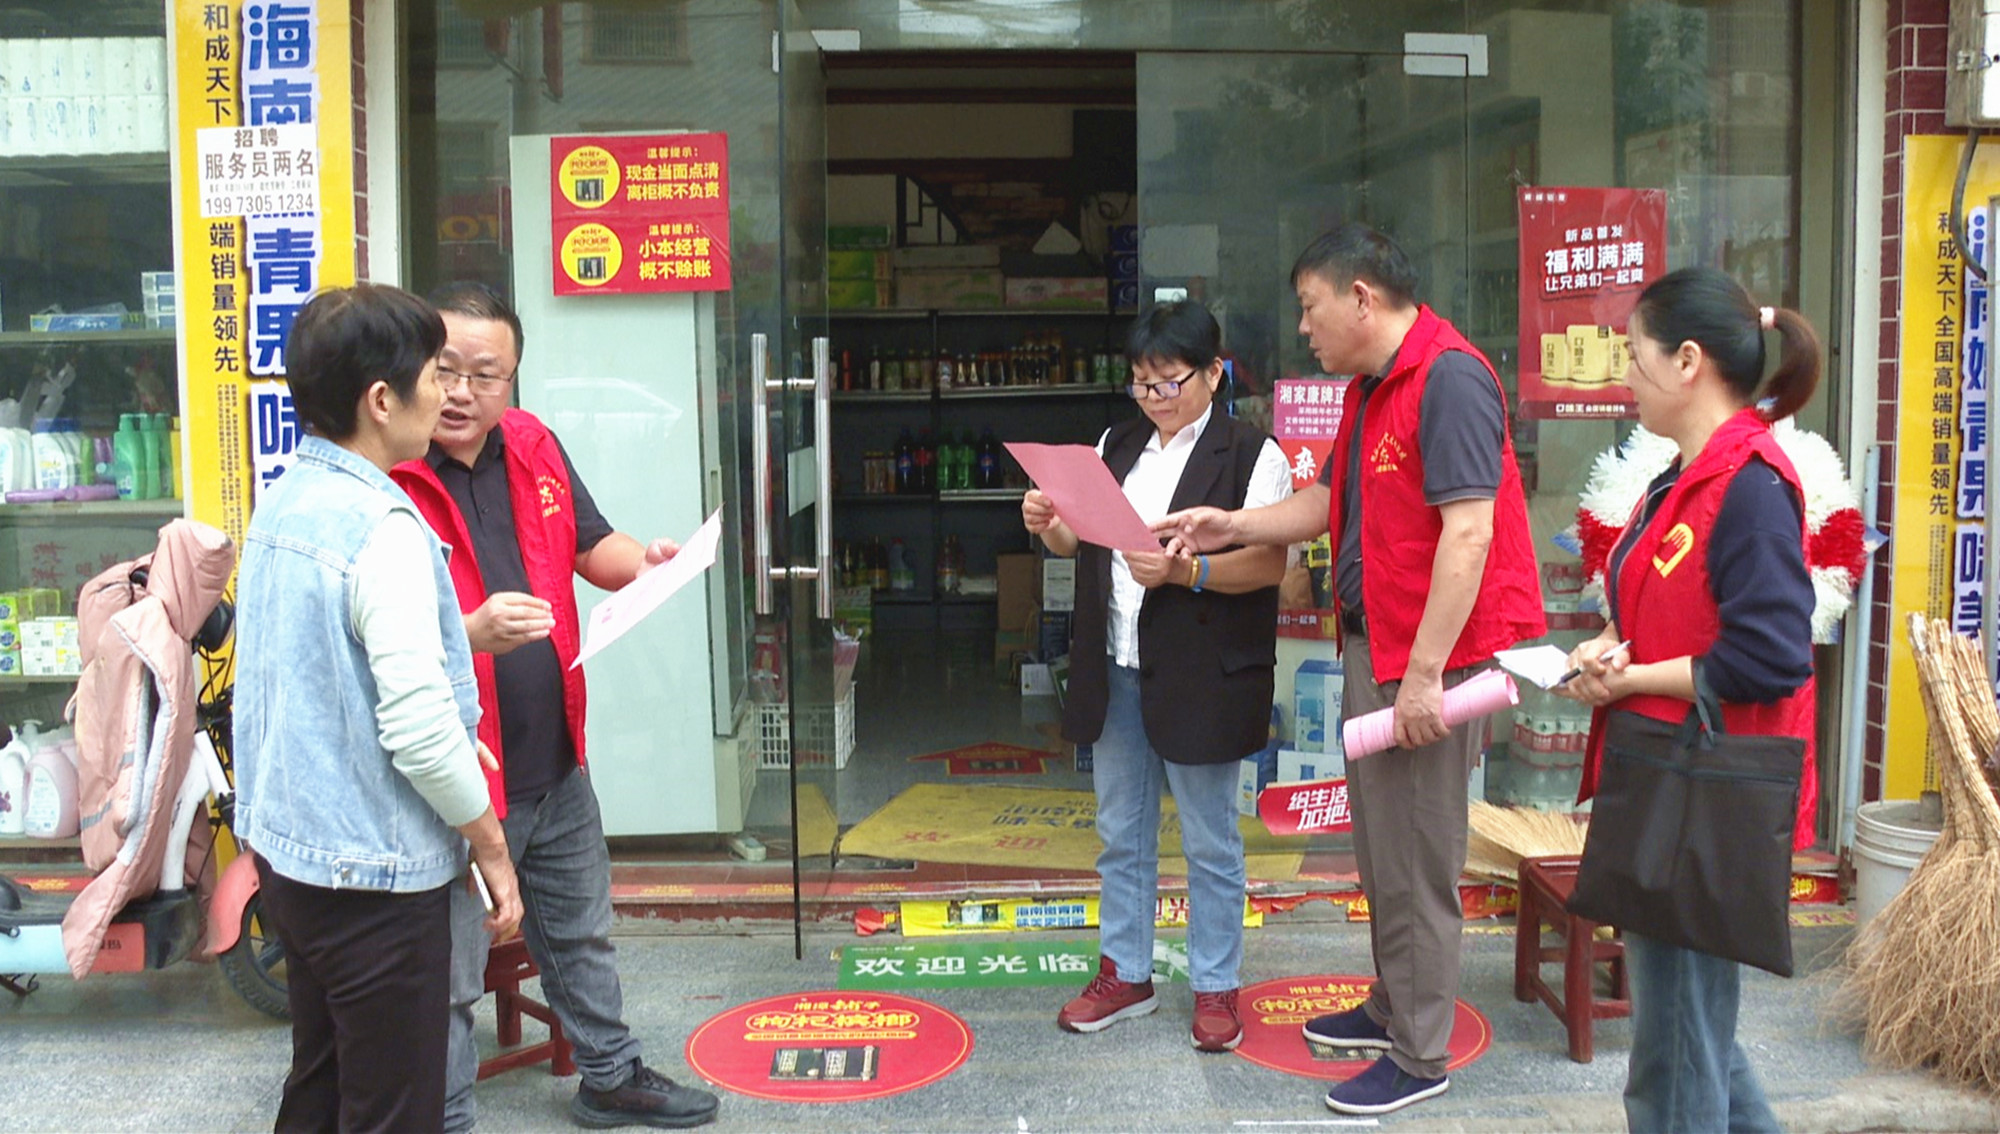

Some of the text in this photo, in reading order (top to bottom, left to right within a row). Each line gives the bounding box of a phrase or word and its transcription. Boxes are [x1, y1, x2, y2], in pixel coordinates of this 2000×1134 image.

[234, 127, 279, 148] 招聘
[205, 148, 314, 180] 服务员两名
[626, 162, 720, 182] 现金当面点清
[203, 4, 240, 373] 和成天下端销量领先
[206, 192, 313, 214] 199 7305 1234
[1565, 224, 1623, 243] 新品首发
[639, 238, 711, 259] 小本经营
[1545, 242, 1644, 275] 福利满满
[639, 260, 712, 282] 概不赊账
[1545, 268, 1644, 292] 让兄弟们一起爽
[1287, 785, 1348, 811] 给生活
[854, 952, 1090, 976] 欢迎光临
